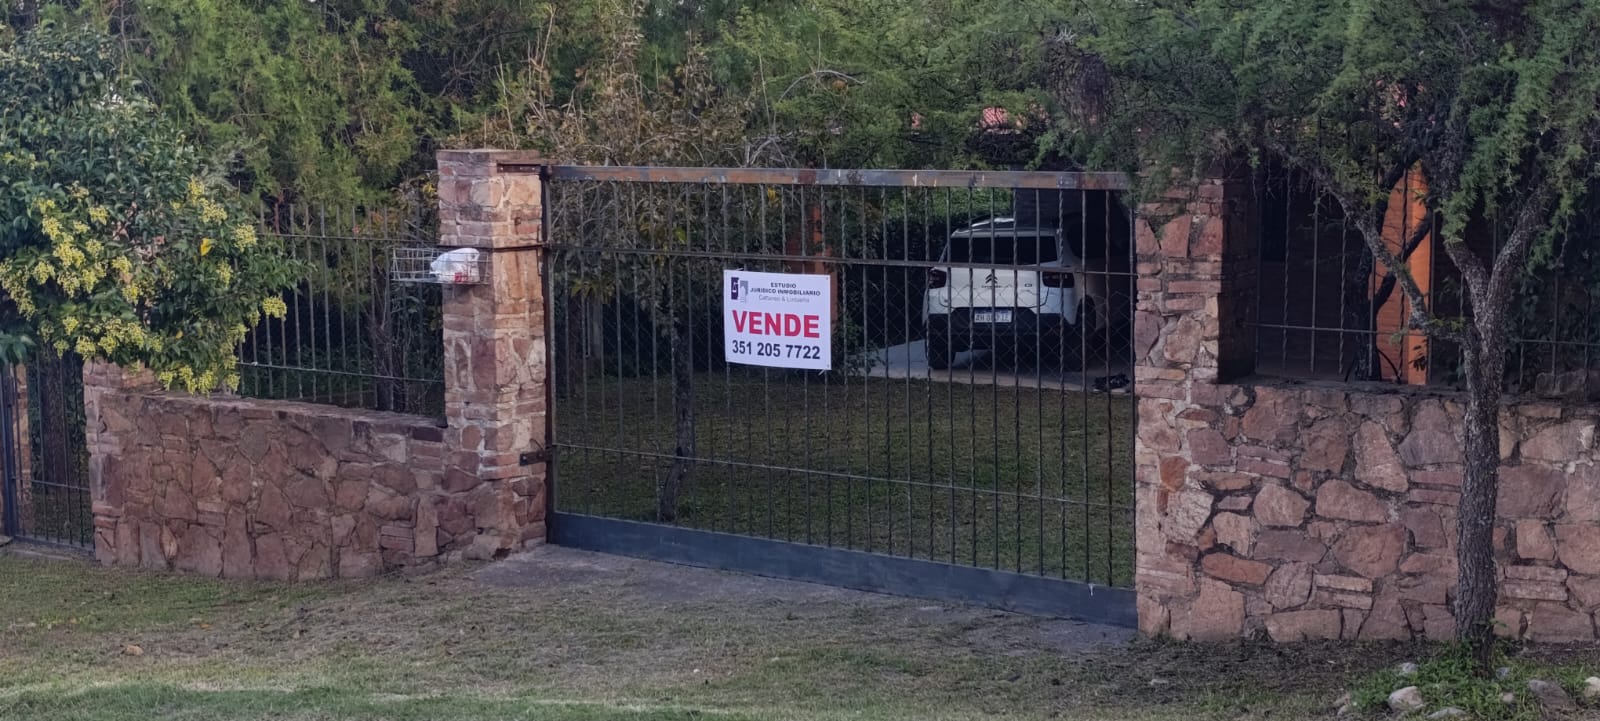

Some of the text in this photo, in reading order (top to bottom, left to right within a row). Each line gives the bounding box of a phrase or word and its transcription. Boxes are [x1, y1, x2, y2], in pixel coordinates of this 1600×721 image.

[732, 310, 820, 338] VENDE
[732, 339, 821, 360] 351 205 7722
